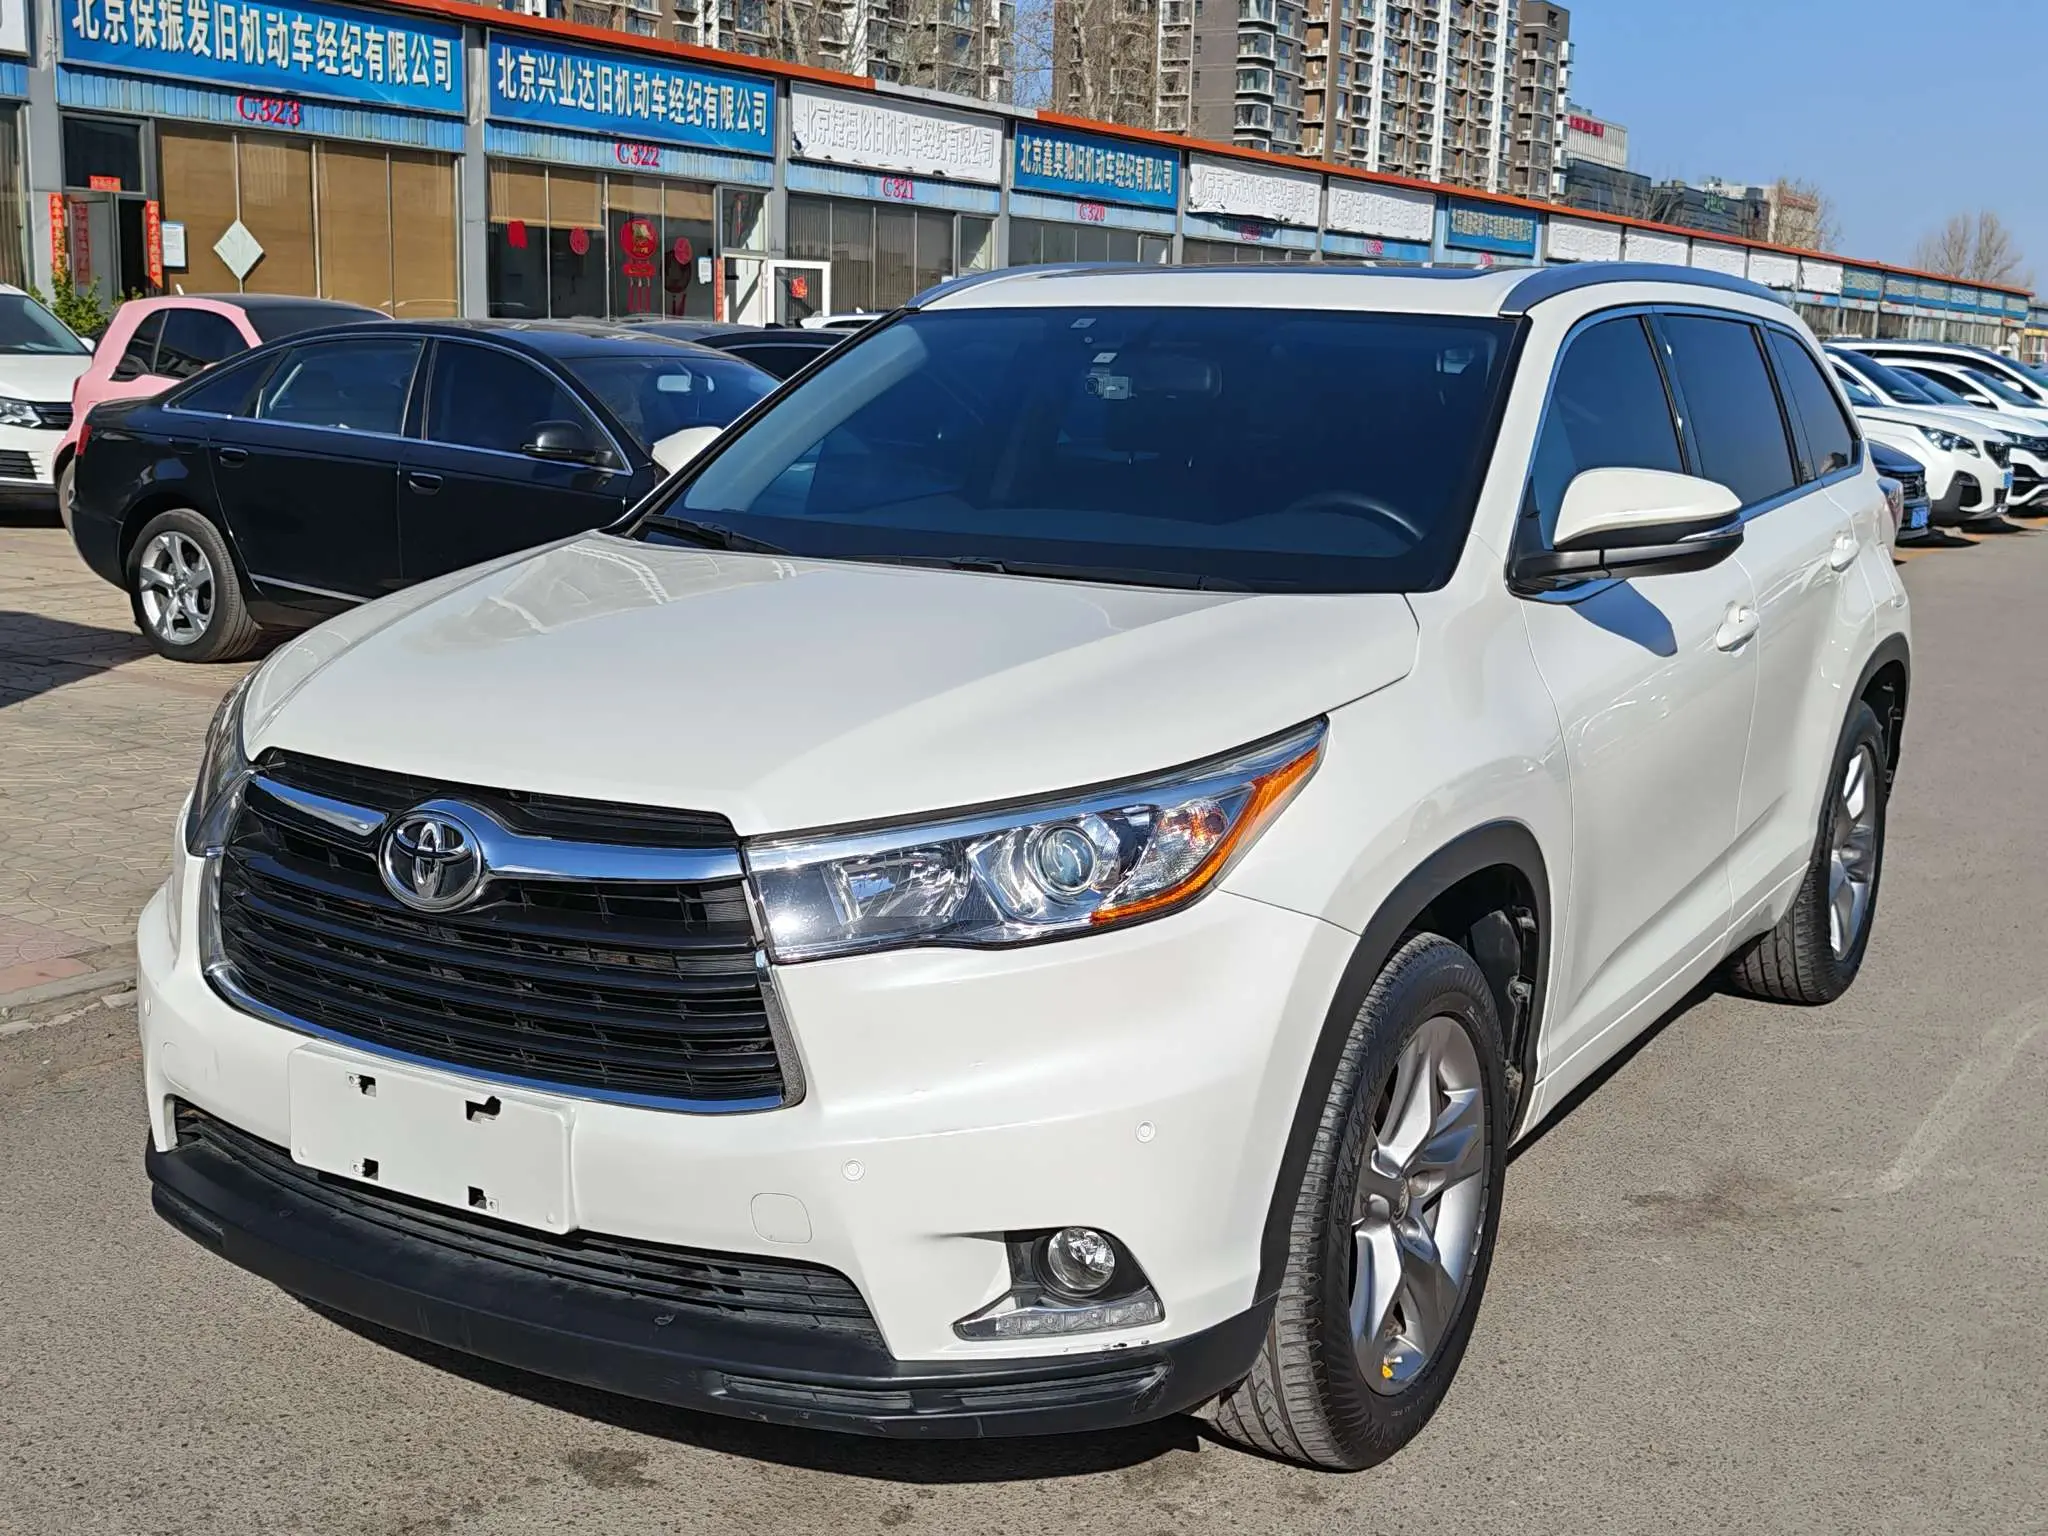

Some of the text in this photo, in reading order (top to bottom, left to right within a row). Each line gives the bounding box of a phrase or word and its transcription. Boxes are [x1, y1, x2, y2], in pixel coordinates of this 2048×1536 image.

[72, 0, 453, 92] 北京保振发旧机动车经纪有限公司
[498, 46, 767, 136] 北京兴业达旧机动车经纪有限公司
[235, 94, 301, 126] C323
[614, 142, 660, 168] C322
[881, 176, 915, 200] C321
